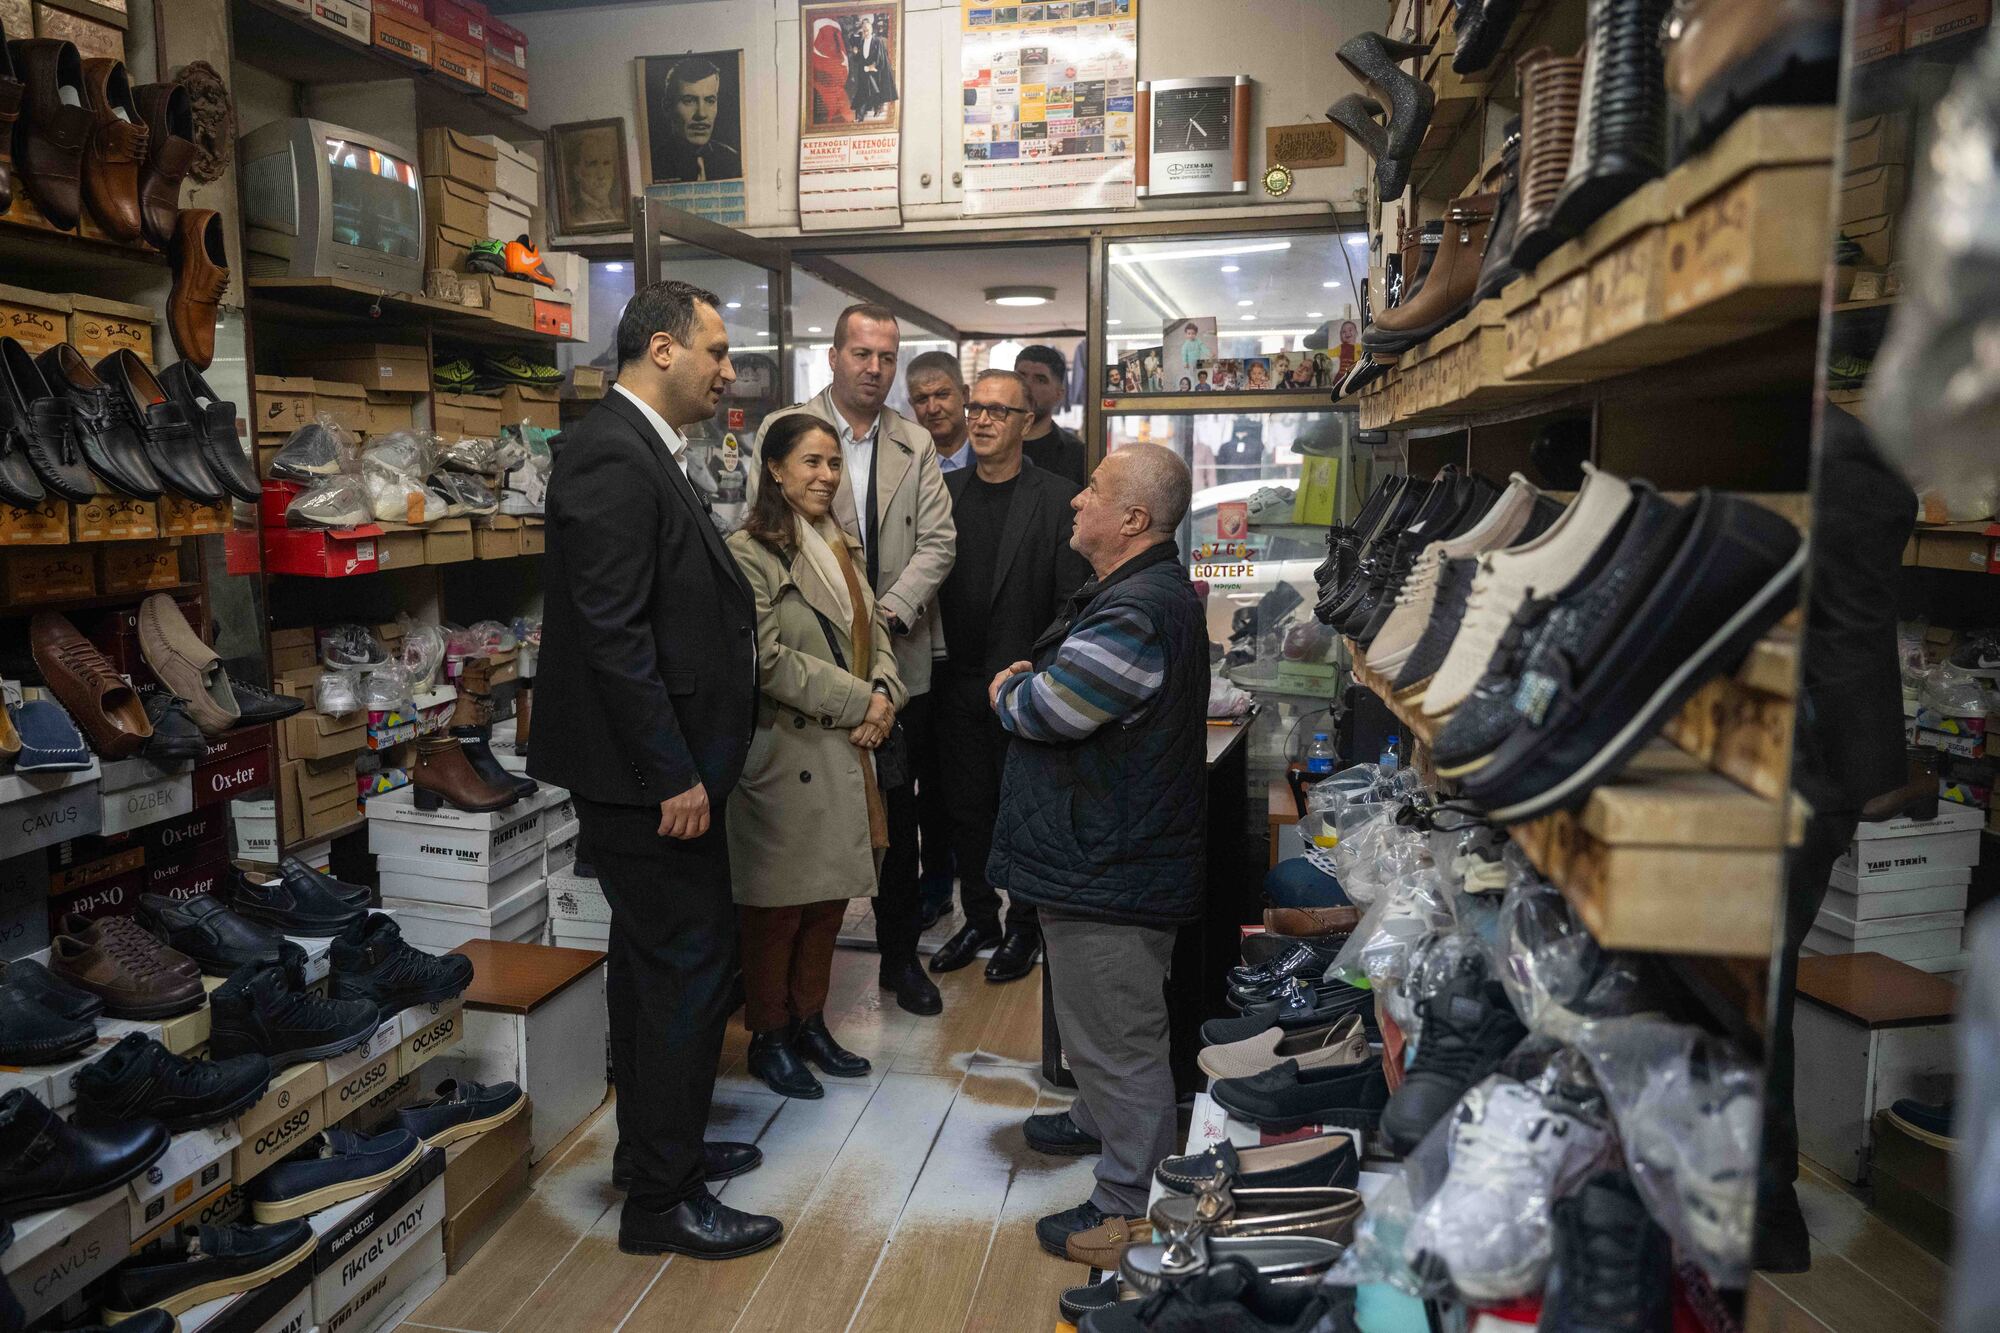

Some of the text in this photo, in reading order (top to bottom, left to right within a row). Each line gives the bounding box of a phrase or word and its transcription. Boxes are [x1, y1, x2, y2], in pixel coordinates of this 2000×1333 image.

[1188, 91, 1198, 99] 12
[810, 147, 841, 155] MARKET
[852, 137, 897, 150] KETENOĞLU
[10, 312, 54, 332] EKO
[104, 323, 142, 341] EKO
[106, 500, 145, 518] EKO
[1192, 543, 1220, 562] GÖZ
[1194, 562, 1255, 578] GÖZTEPE
[132, 682, 156, 695] x-ter
[211, 766, 255, 792] Ox-ter
[127, 789, 175, 814] ÖZBEK
[22, 806, 78, 833] ÇAVUŞ
[161, 820, 207, 847] Ox-ter
[420, 843, 480, 859] FİKRET UNAY
[153, 863, 180, 882] Ox-ter
[72, 886, 124, 914] Ox-ter
[412, 1018, 454, 1053] OCASSO
[340, 1062, 387, 1101] OCASSO
[255, 1109, 310, 1155] OCASSO
[201, 1186, 248, 1224] OCASS
[33, 1240, 100, 1297] ÇAVUŞ
[354, 1275, 387, 1312] FİKRET
